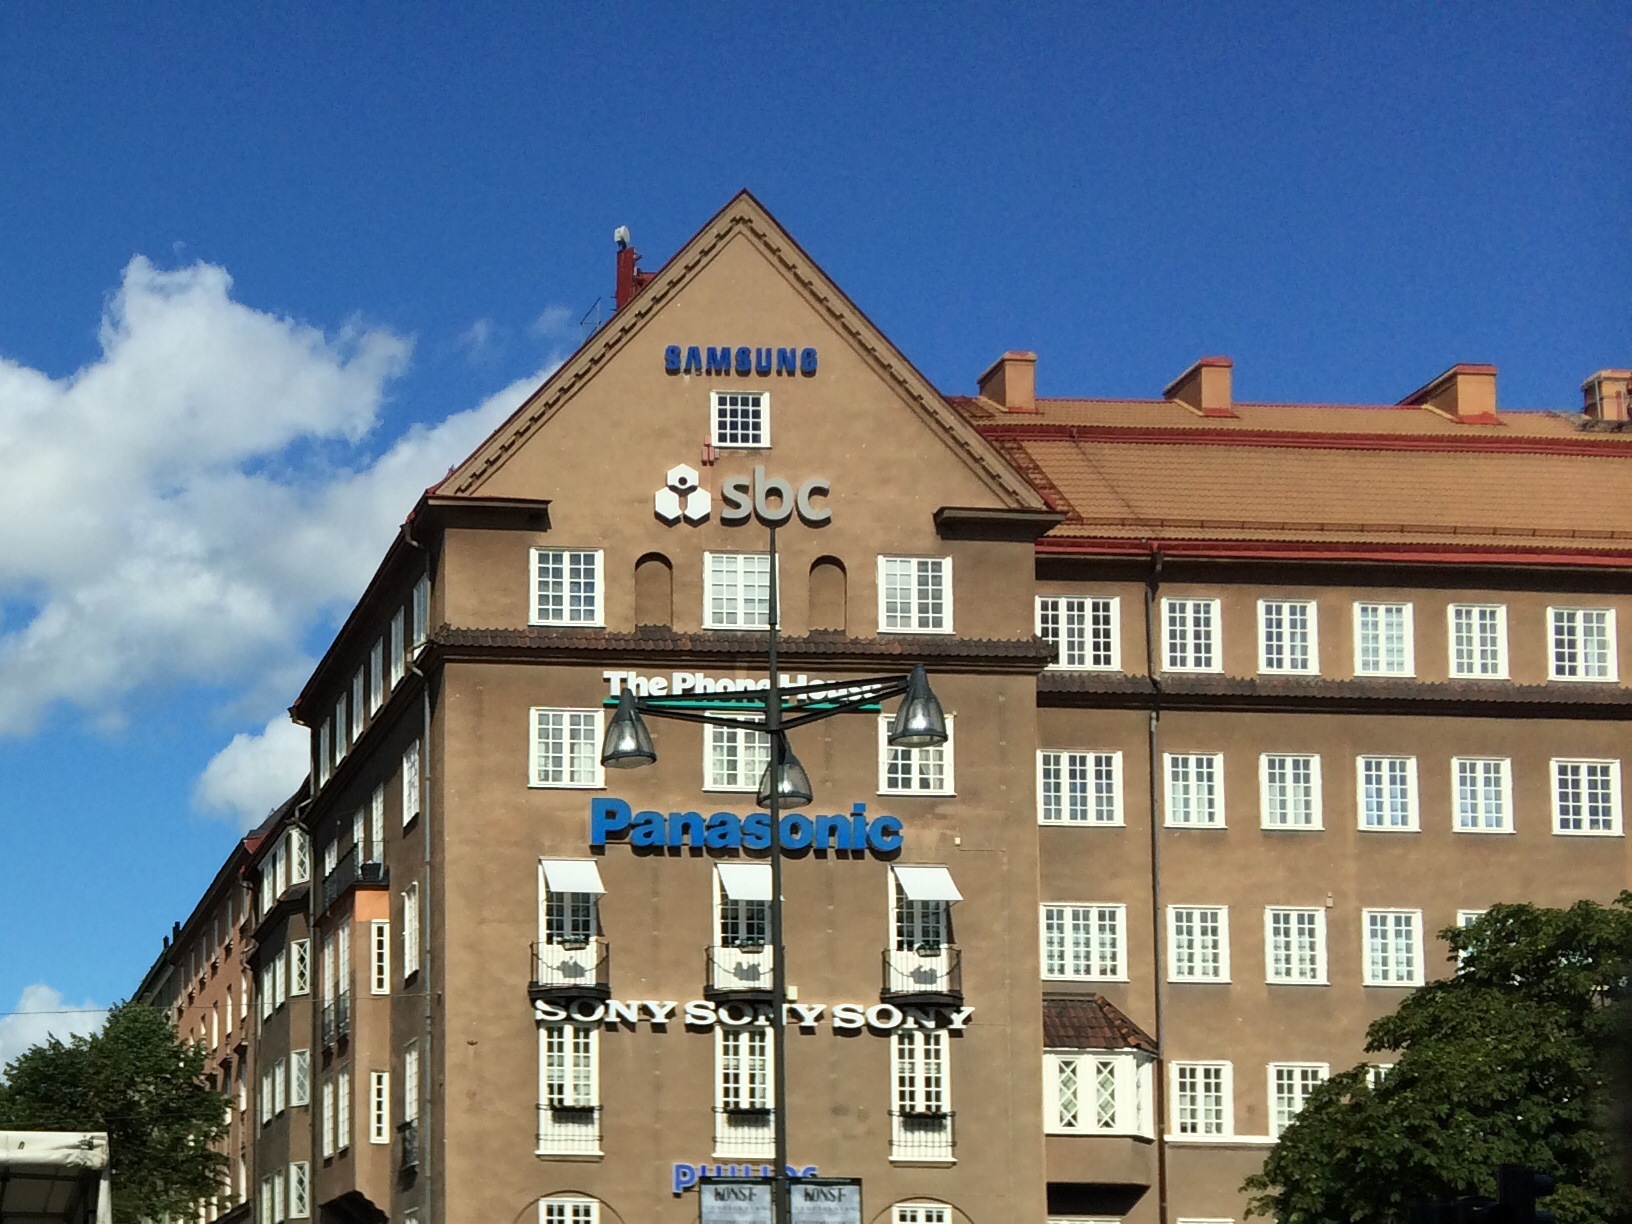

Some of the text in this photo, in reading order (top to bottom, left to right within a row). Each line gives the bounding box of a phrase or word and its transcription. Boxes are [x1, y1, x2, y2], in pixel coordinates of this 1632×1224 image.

[665, 345, 818, 375] SAMSUNG
[721, 466, 833, 524] sbc
[603, 671, 668, 697] The
[591, 797, 904, 853] Panasonic
[535, 1000, 678, 1022] SONY
[832, 1003, 976, 1029] SONY
